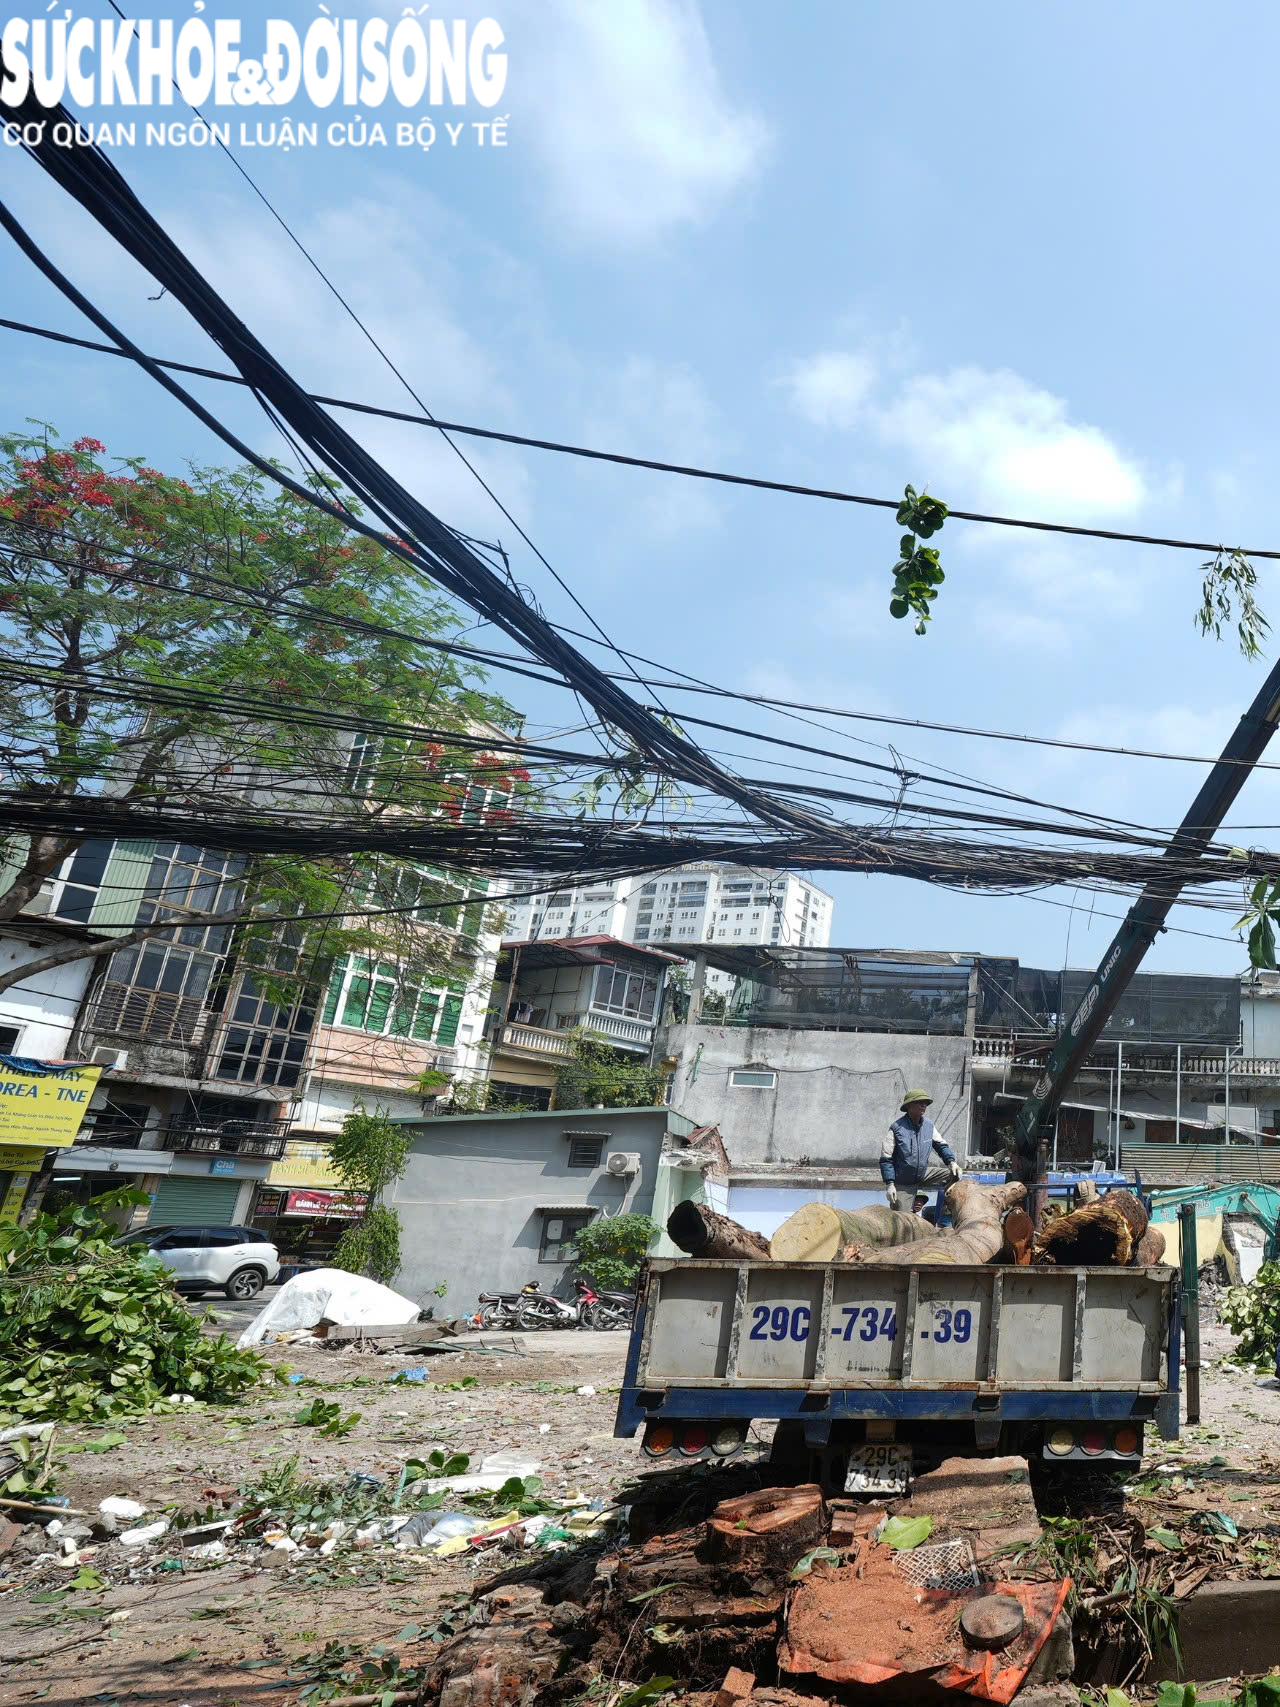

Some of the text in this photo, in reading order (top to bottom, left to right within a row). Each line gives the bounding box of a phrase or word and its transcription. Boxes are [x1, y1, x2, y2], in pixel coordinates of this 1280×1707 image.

[0, 1081, 38, 1098] REA
[56, 1087, 89, 1103] TNE
[750, 1306, 810, 1342] 29C
[863, 1446, 899, 1467] 29C
